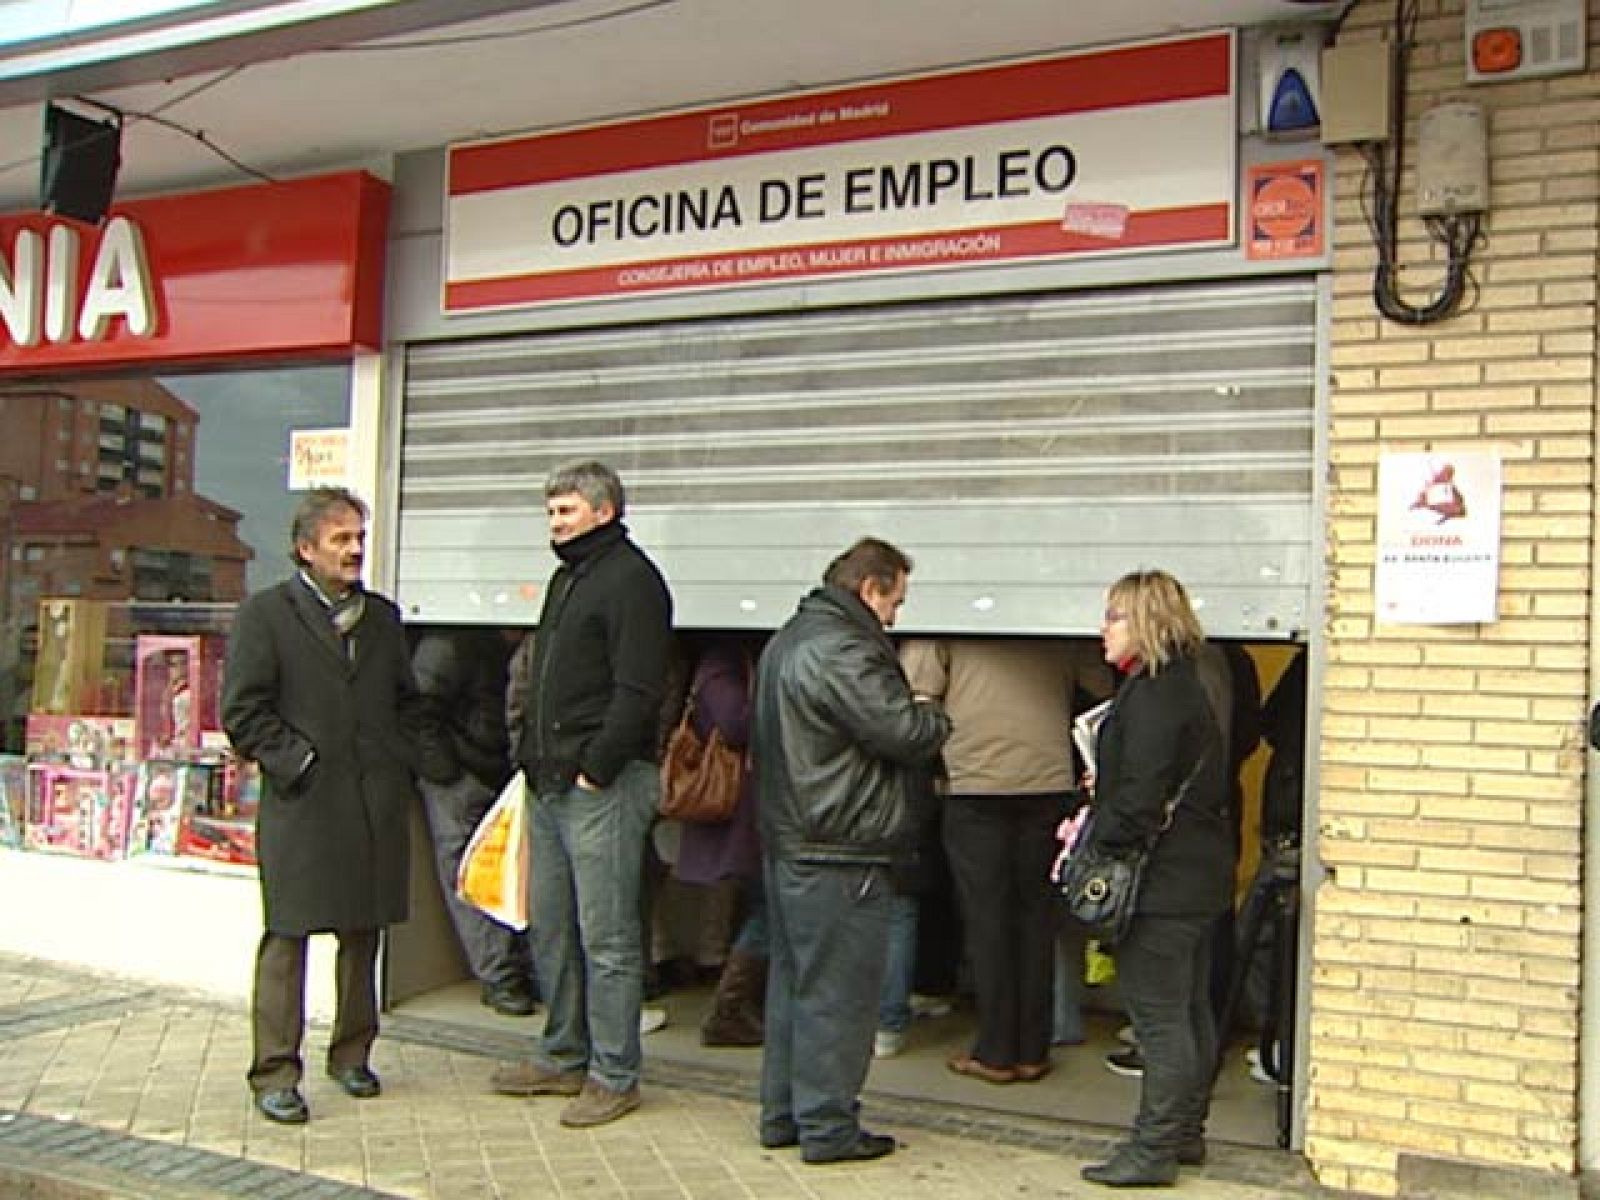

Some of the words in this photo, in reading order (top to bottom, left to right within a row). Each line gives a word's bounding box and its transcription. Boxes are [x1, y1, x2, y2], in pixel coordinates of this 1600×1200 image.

[740, 112, 816, 136] Comunidad
[820, 110, 836, 124] de
[840, 102, 890, 121] Madrid
[551, 185, 742, 247] OFICINA
[759, 174, 826, 223] DE
[844, 144, 1077, 215] EMPLEO
[713, 258, 735, 278] DE
[809, 245, 866, 267] MUJER
[869, 245, 881, 262] E
